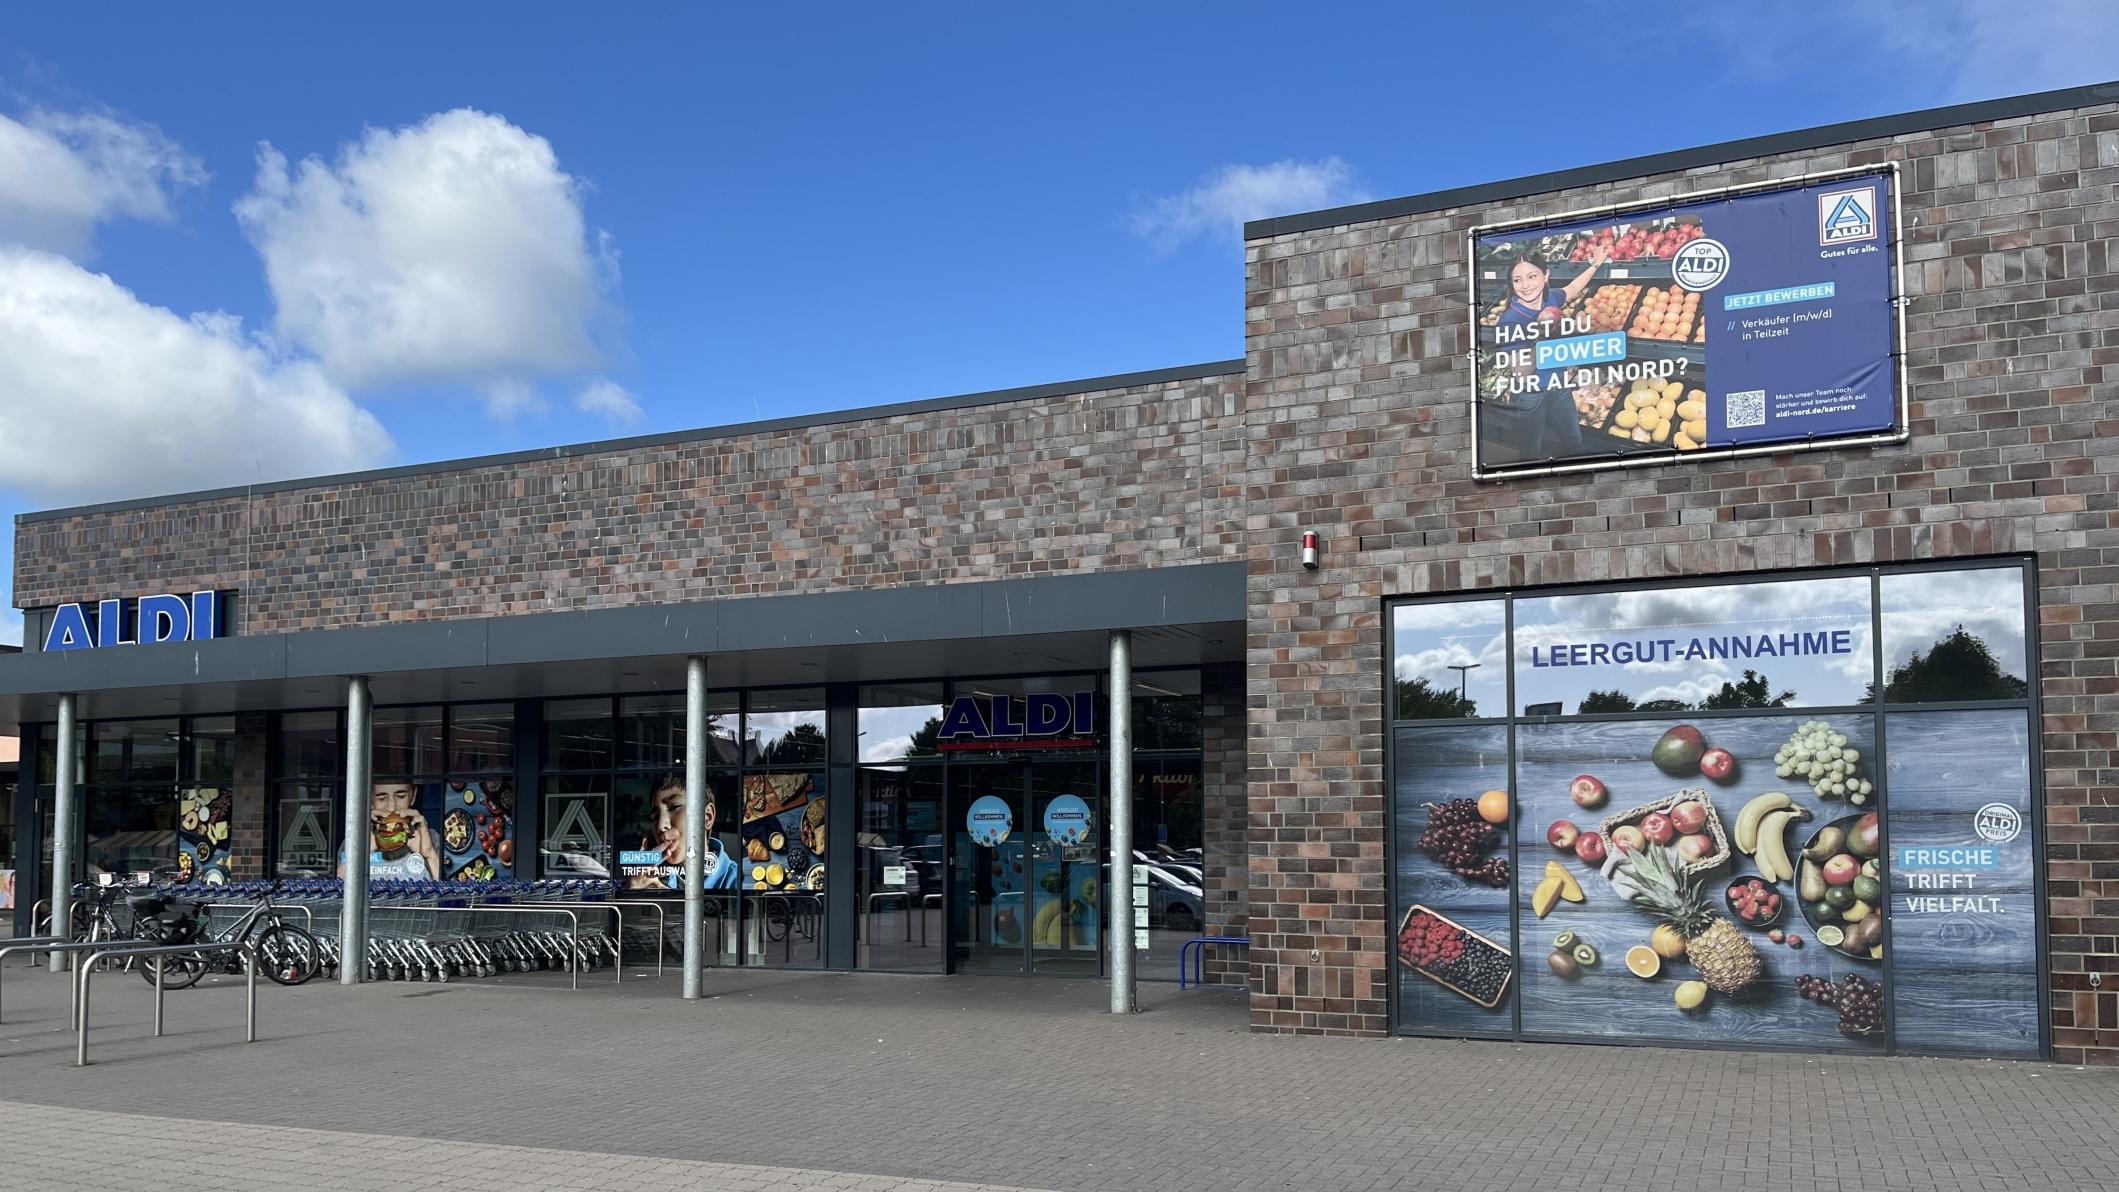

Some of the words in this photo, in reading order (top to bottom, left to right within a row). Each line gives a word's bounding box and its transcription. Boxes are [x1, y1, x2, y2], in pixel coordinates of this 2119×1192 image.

[1831, 225, 1867, 238] ALDI
[1821, 250, 1845, 258] Gutes
[1847, 247, 1859, 255] für
[1862, 244, 1878, 253] alle.
[1678, 257, 1724, 272] ALDI
[1727, 295, 1762, 308] JETZT
[1764, 284, 1833, 303] BEWERBEN
[1742, 314, 1790, 328] Verkäufer
[1793, 308, 1832, 323] (m/w/d)
[1495, 320, 1554, 344] HAST
[1561, 315, 1591, 336] DU
[1742, 331, 1751, 341] in
[1754, 327, 1789, 339] Teilzeit
[1495, 348, 1532, 369] DIE
[1539, 337, 1622, 364] POWER
[1496, 373, 1541, 396] FÜR
[1547, 367, 1599, 391] ALDI
[1608, 357, 1688, 384] NORD?
[1794, 391, 1814, 399] unser
[1835, 386, 1852, 394] noch
[1776, 401, 1800, 409] stärker
[1801, 399, 1814, 407] und
[1815, 396, 1838, 405] bewirb
[1839, 394, 1853, 402] dich
[1775, 403, 1856, 418] aldi-nord.de/karriere
[43, 590, 216, 652] ALDI
[1532, 630, 1851, 667] LEERGUT-ANNAHME
[937, 691, 1093, 739] ALDI
[1984, 810, 2014, 819] ORIGINAL
[1980, 816, 2016, 831] ALDI
[1985, 829, 2007, 837] PREIS
[622, 852, 660, 862] GÜNSTIG
[1904, 849, 1993, 865] FRISCHE
[622, 866, 651, 876] TRIFFT
[654, 866, 686, 876] AUSWA
[1904, 873, 1977, 889] TRIFFT
[1905, 897, 2005, 913] VIELFALT.
